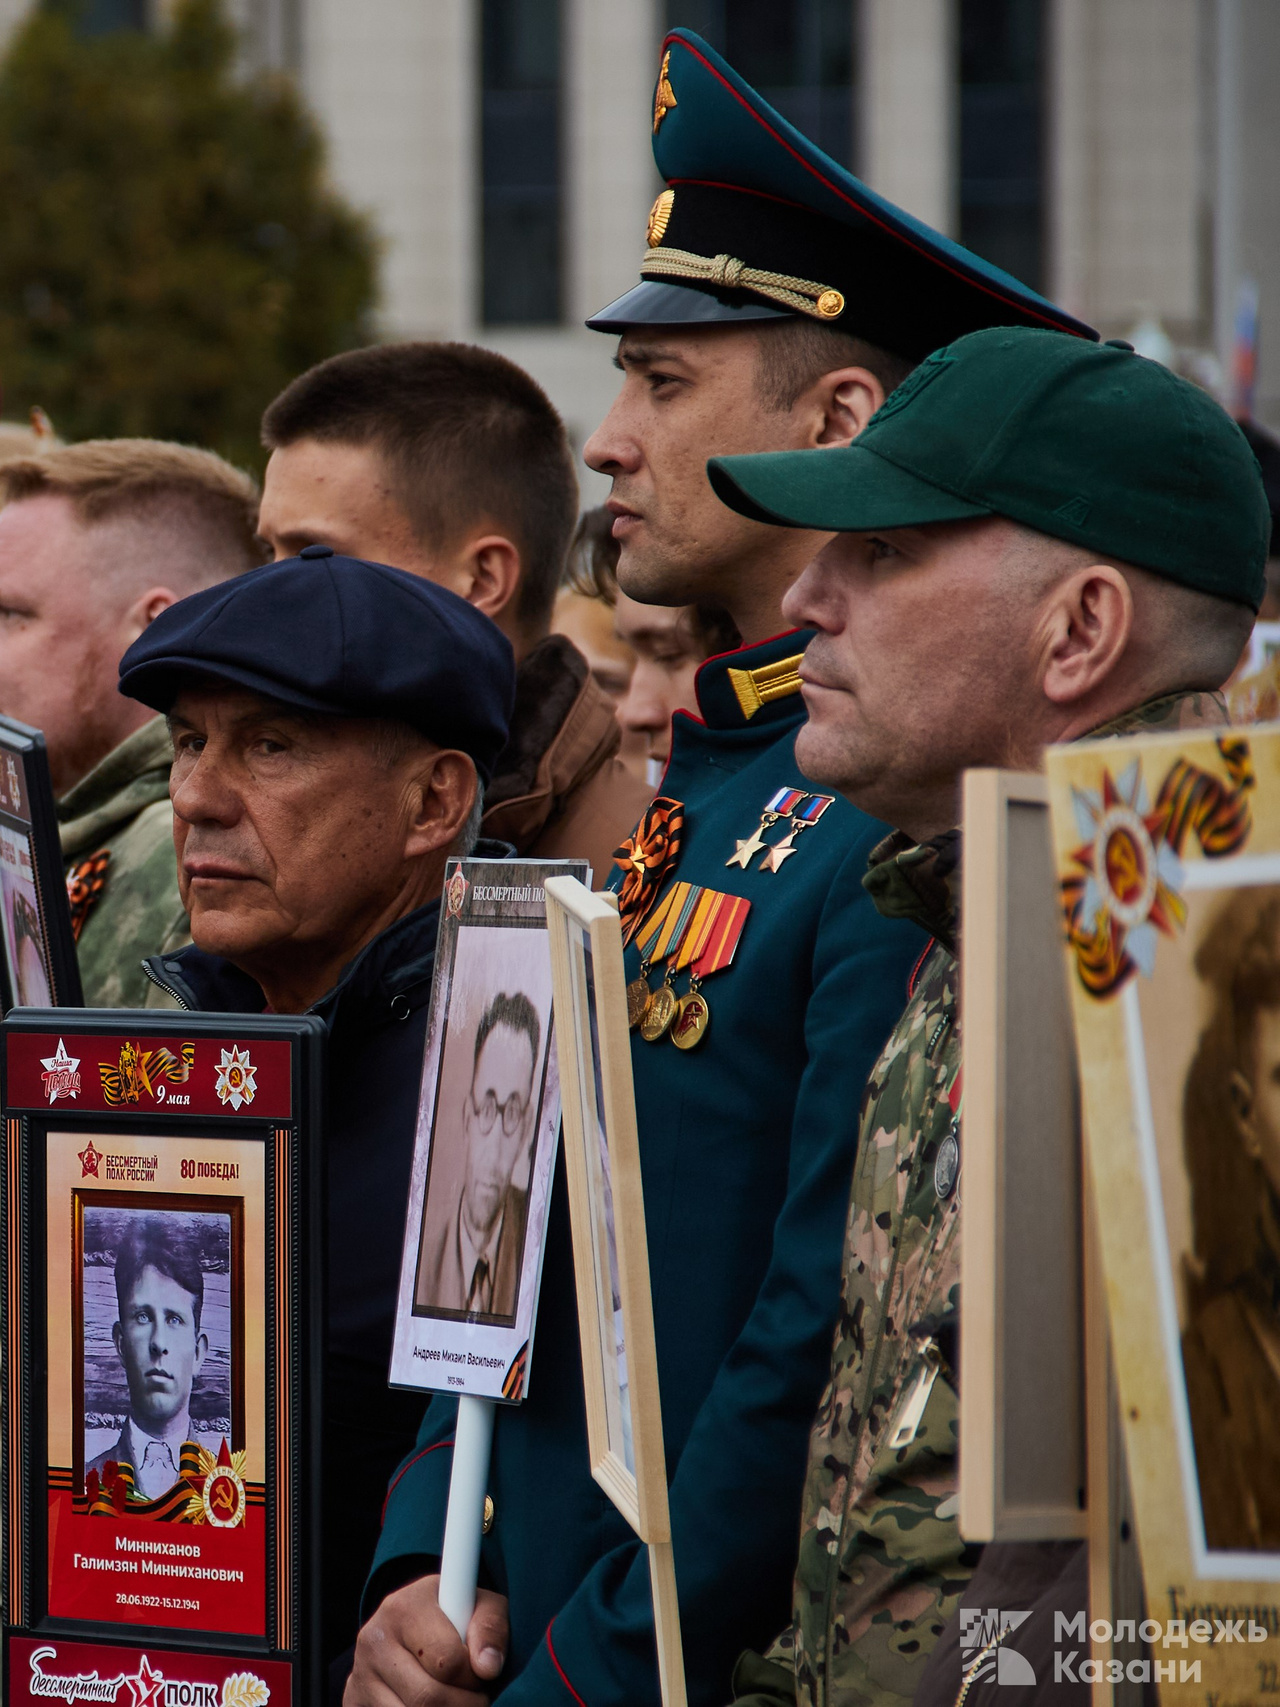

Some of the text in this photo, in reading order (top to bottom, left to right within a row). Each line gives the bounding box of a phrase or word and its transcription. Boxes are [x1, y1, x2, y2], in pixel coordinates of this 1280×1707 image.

[473, 883, 546, 902] БЕССМЕРТНЫЙ ПО
[156, 1084, 191, 1105] 9 мая
[106, 1154, 159, 1170] БЕССМЕРТНЫЙ
[181, 1159, 240, 1181] 80 ПОБЕДА!
[106, 1168, 155, 1181] ПОЛК РОССИИ
[412, 1345, 505, 1369] Андреев Михаил Васильевич
[115, 1536, 201, 1558] Минниханов
[73, 1553, 244, 1583] Галимзян Минниханович
[116, 1593, 200, 1611] 28.06.1922-15.12.1941
[167, 1683, 218, 1707] ПОЛК
